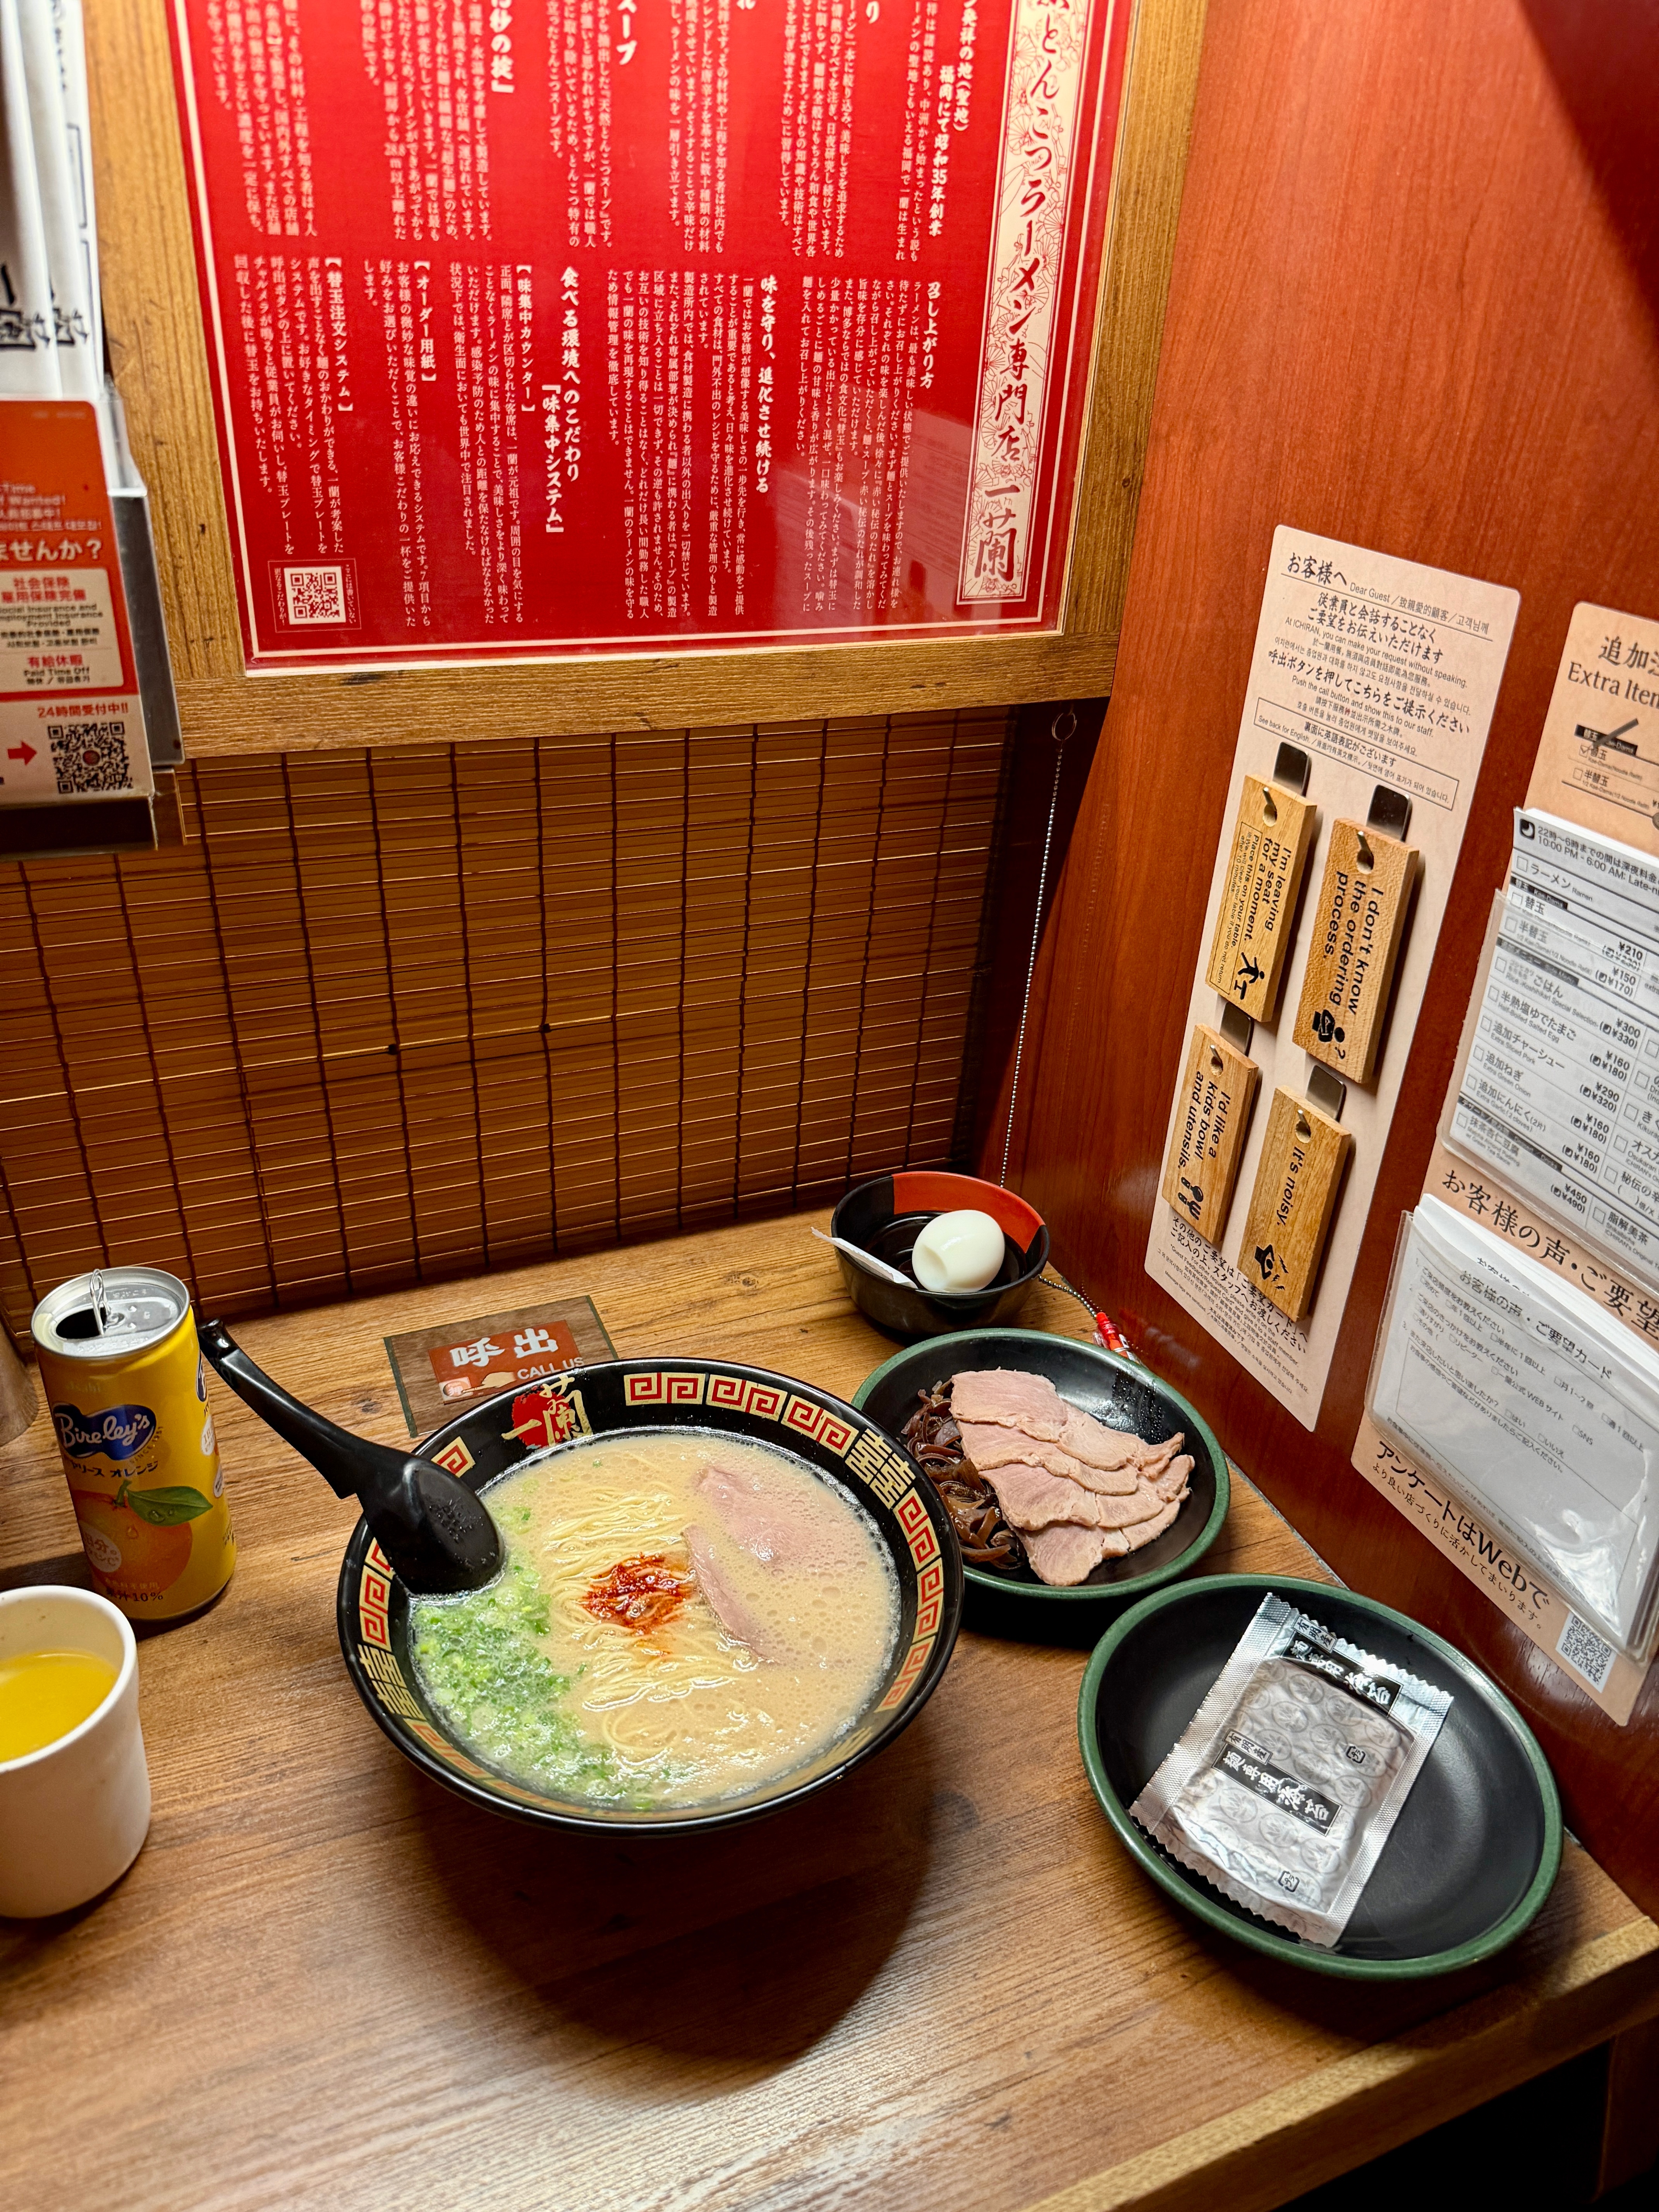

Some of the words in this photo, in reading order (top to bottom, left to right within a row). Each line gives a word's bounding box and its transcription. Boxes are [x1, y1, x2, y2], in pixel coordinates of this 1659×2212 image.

[364, 260, 378, 306] します。
[414, 261, 436, 381] 【オーダー用紙】
[698, 273, 709, 349] されています。
[325, 258, 353, 411] 【替玉注文システム】
[516, 265, 535, 412] 【味集中カウンター】
[607, 269, 619, 445] ため情報管理を徹底しています。
[920, 282, 941, 389] 召し上がり方
[561, 266, 581, 482] 食べる環境へのこだわり
[756, 275, 778, 493] 味を守り、進化させ続ける
[849, 278, 867, 455] 旨味を存分に感じていただけます。
[1287, 552, 1347, 586] お客様へ
[1350, 582, 1367, 595] Dear
[1369, 588, 1390, 603] Guest
[1308, 608, 1443, 664] ご要望をお伝えいただけます
[1317, 592, 1436, 644] 従業員と会話することなく
[1285, 617, 1292, 626] At
[1293, 619, 1320, 636] ICHIRAN,
[1322, 631, 1334, 640] you
[1335, 635, 1346, 644] can
[1347, 640, 1365, 651] make
[1366, 646, 1381, 656] your
[1382, 652, 1407, 666] request
[1408, 661, 1433, 675] without
[1434, 670, 1467, 689] speaking.
[1268, 649, 1469, 733] 呼出ボタンを押してこちらをご提示ください
[1567, 661, 1621, 696] Extra
[1292, 675, 1307, 687] Push
[1308, 682, 1317, 692] the
[1319, 687, 1329, 696] call
[1330, 690, 1349, 704] button
[1351, 700, 1363, 709] and
[1364, 704, 1381, 716] show
[1382, 711, 1394, 722] this
[1396, 716, 1402, 725] to
[1404, 721, 1416, 730] our
[1417, 726, 1433, 738] staff.
[1304, 721, 1396, 767] 裏面に英語表記がございます
[1249, 834, 1259, 862] Place
[1259, 863, 1266, 872] a
[1262, 837, 1273, 860] for
[1269, 841, 1281, 867] my
[1279, 847, 1291, 871] I'm
[1539, 836, 1562, 852] 10:00
[1564, 847, 1578, 859] PM
[1586, 857, 1606, 872] 6:00
[1242, 884, 1247, 897] on
[1262, 870, 1274, 904] seat
[1265, 875, 1286, 931] leaving
[1350, 880, 1367, 913] the
[1371, 887, 1384, 896] I
[1525, 896, 1545, 915] 替玉
[1531, 863, 1571, 888] ラーメン
[1572, 887, 1593, 902] Ramen
[1244, 877, 1263, 941] moment.
[1322, 871, 1348, 959] process.
[1359, 900, 1380, 955] don't
[1231, 923, 1240, 948] table.
[1329, 919, 1356, 1006] ordering
[1348, 959, 1369, 1015] know
[1534, 975, 1563, 998] ごはん
[1484, 1051, 1524, 1082] 追加ねぎ
[1491, 1021, 1565, 1069] 追加チャーシュー
[1192, 1071, 1204, 1105] and
[1203, 1081, 1218, 1116] kids
[1218, 1091, 1231, 1115] I'd
[1178, 1106, 1197, 1169] utensils.
[1194, 1118, 1210, 1160] bowl
[1208, 1147, 1216, 1158] a
[1212, 1115, 1226, 1144] like
[1290, 1146, 1305, 1174] It's
[1276, 1176, 1295, 1226] noisy.
[449, 1328, 559, 1367] 呼出
[517, 1362, 562, 1381] CALL
[562, 1357, 585, 1370] US
[110, 1460, 160, 1478] オレンジ
[1372, 1463, 1543, 1630] より良い店づくりに活かしてまいります。
[1376, 1440, 1551, 1611] アンケートはWebで
